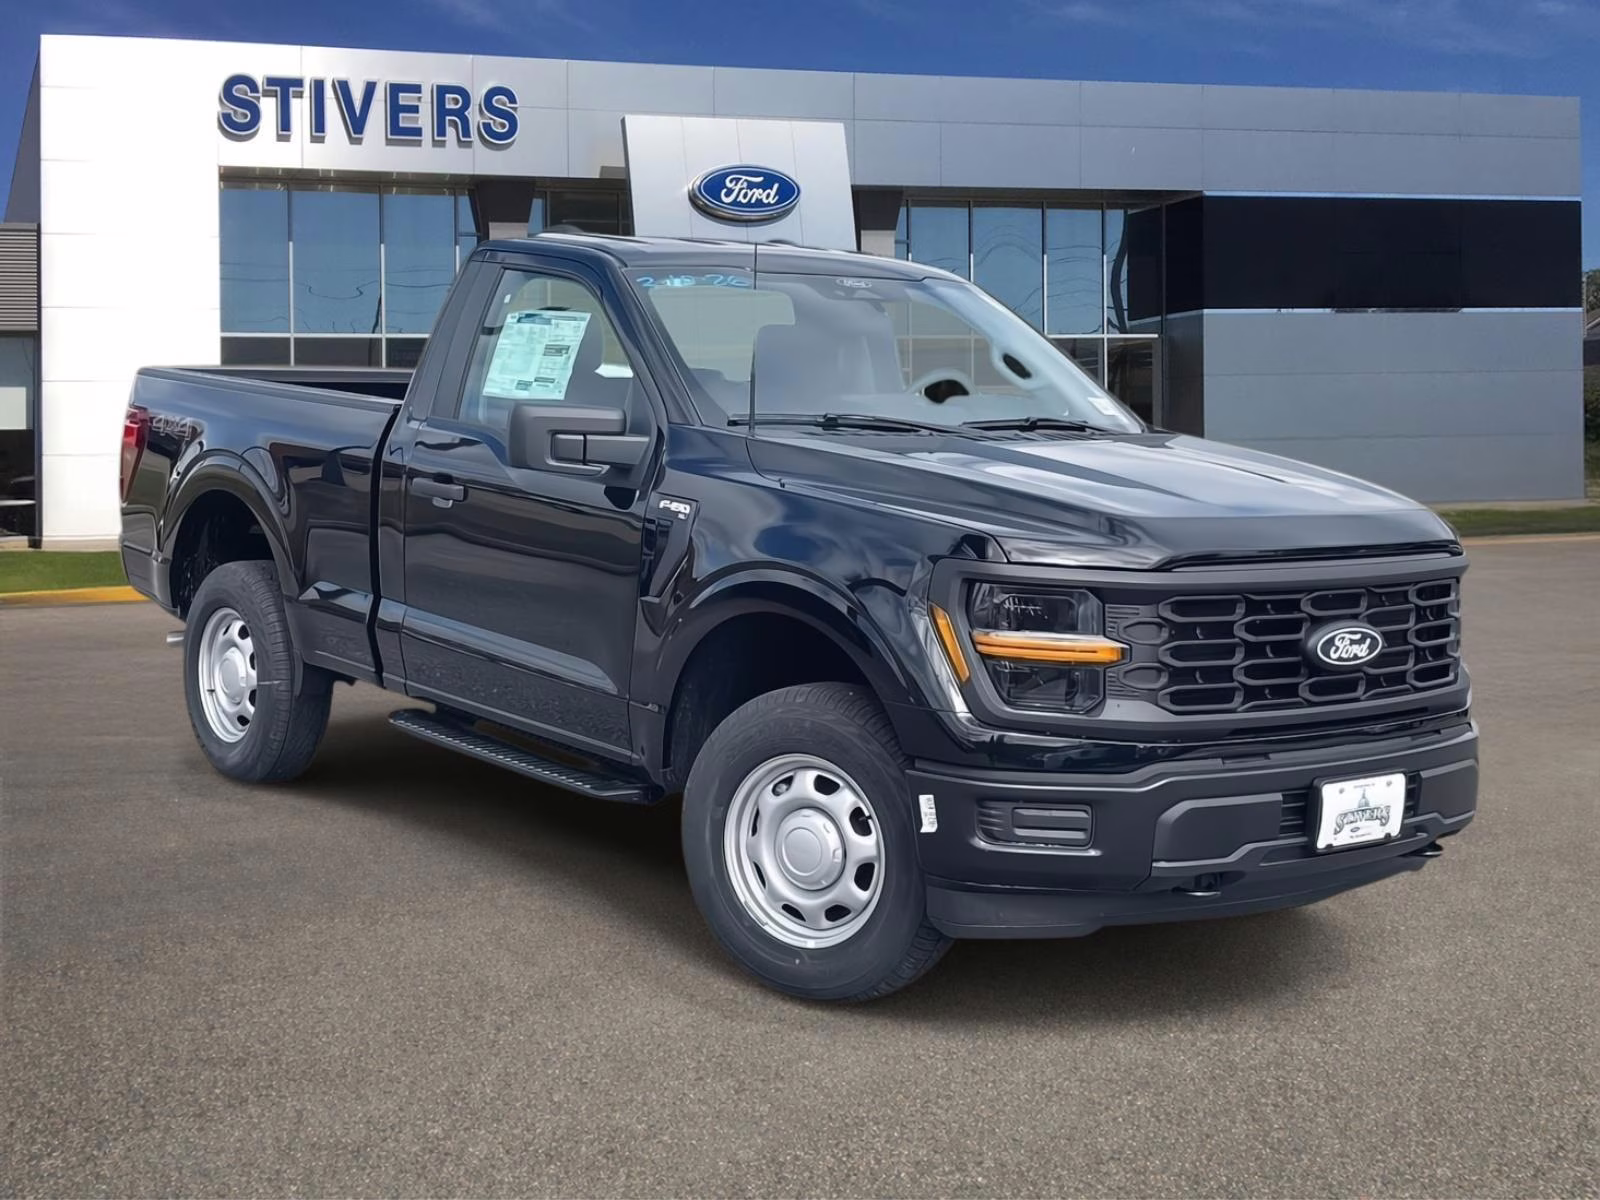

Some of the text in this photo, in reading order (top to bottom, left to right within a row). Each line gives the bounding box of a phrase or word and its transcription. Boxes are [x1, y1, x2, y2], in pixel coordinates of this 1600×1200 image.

[218, 73, 519, 144] STIVERS
[720, 174, 780, 204] Ford
[1329, 632, 1372, 660] Ford
